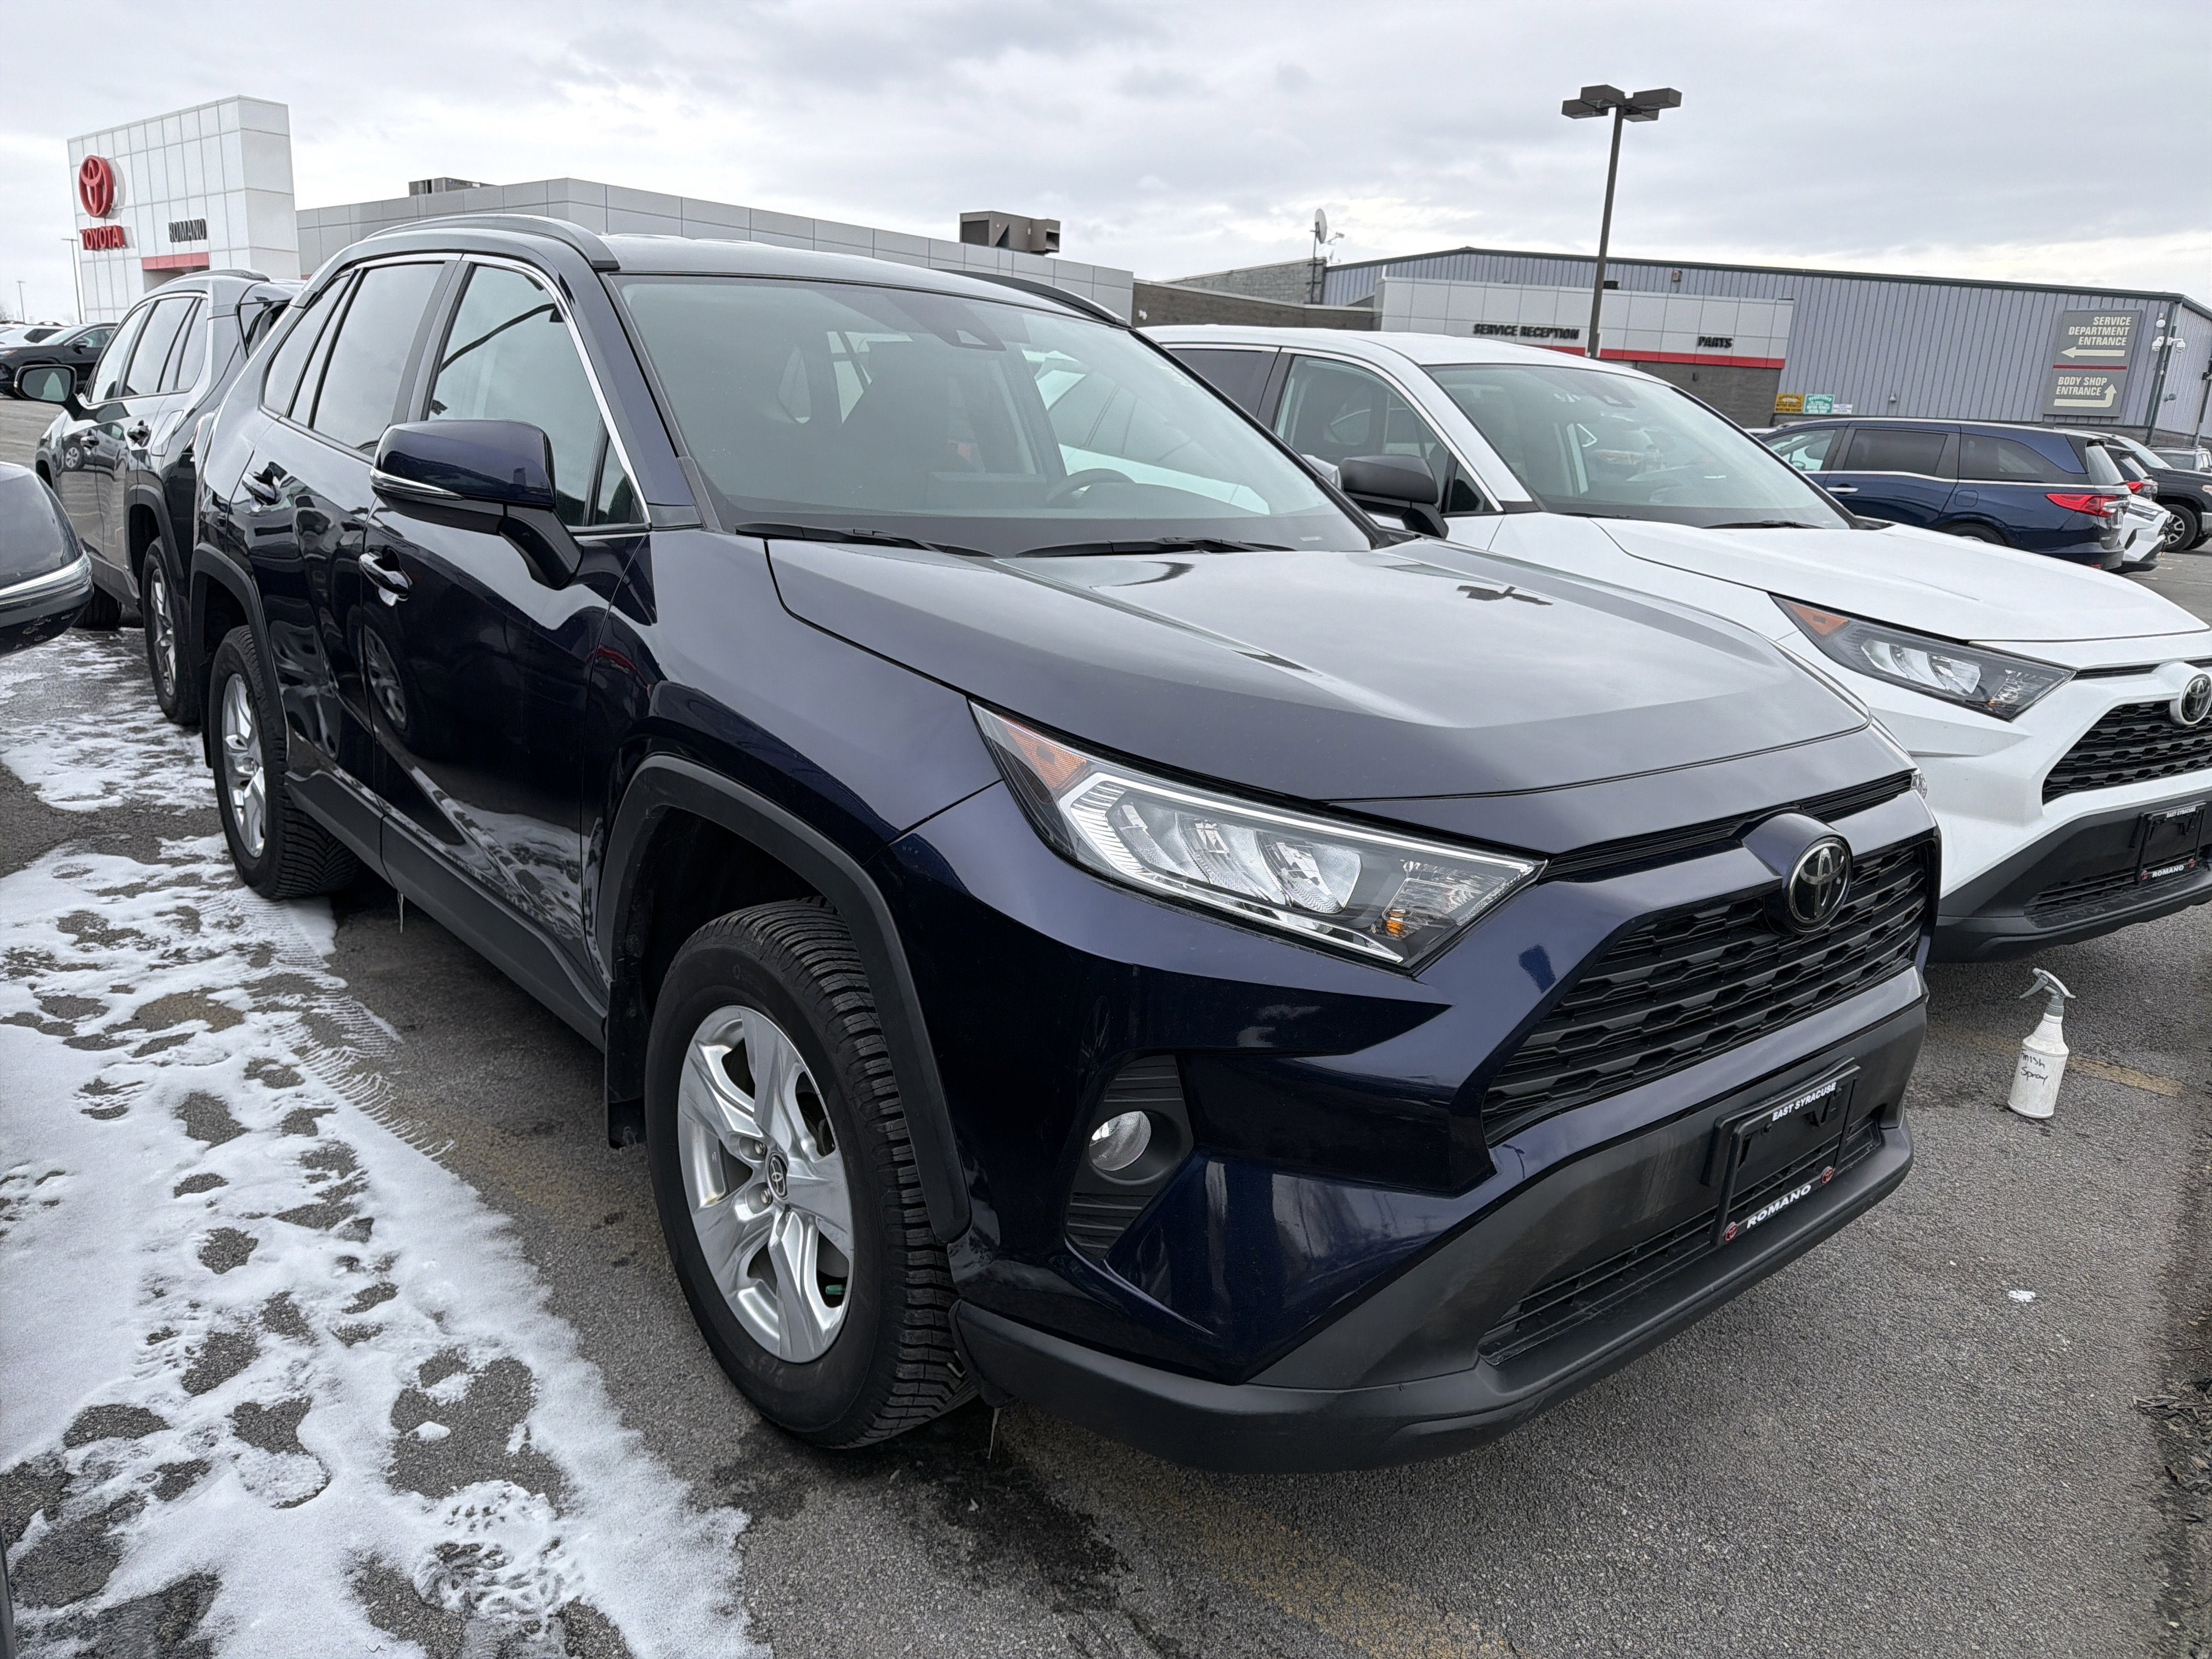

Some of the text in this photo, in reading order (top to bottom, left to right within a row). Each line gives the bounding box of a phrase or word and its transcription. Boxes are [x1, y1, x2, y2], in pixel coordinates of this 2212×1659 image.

[169, 219, 207, 242] ROMANO
[80, 225, 126, 250] TOYOTA
[2094, 317, 2132, 325] SERVICE
[1474, 324, 1580, 340] SERVICE RECEPTION
[2069, 326, 2130, 336] DEPARTMENT
[1698, 336, 1733, 348] PARTS
[2079, 336, 2128, 346] ENTRANCE
[2058, 376, 2108, 386] BODY SHOP
[2056, 386, 2102, 396] ENTRANCE
[2152, 865, 2185, 878] ROMANO
[2021, 1066, 2049, 1086] Spray
[1772, 1082, 1837, 1121] EAST SYRACUSE
[1746, 1184, 1812, 1229] ROMANO
